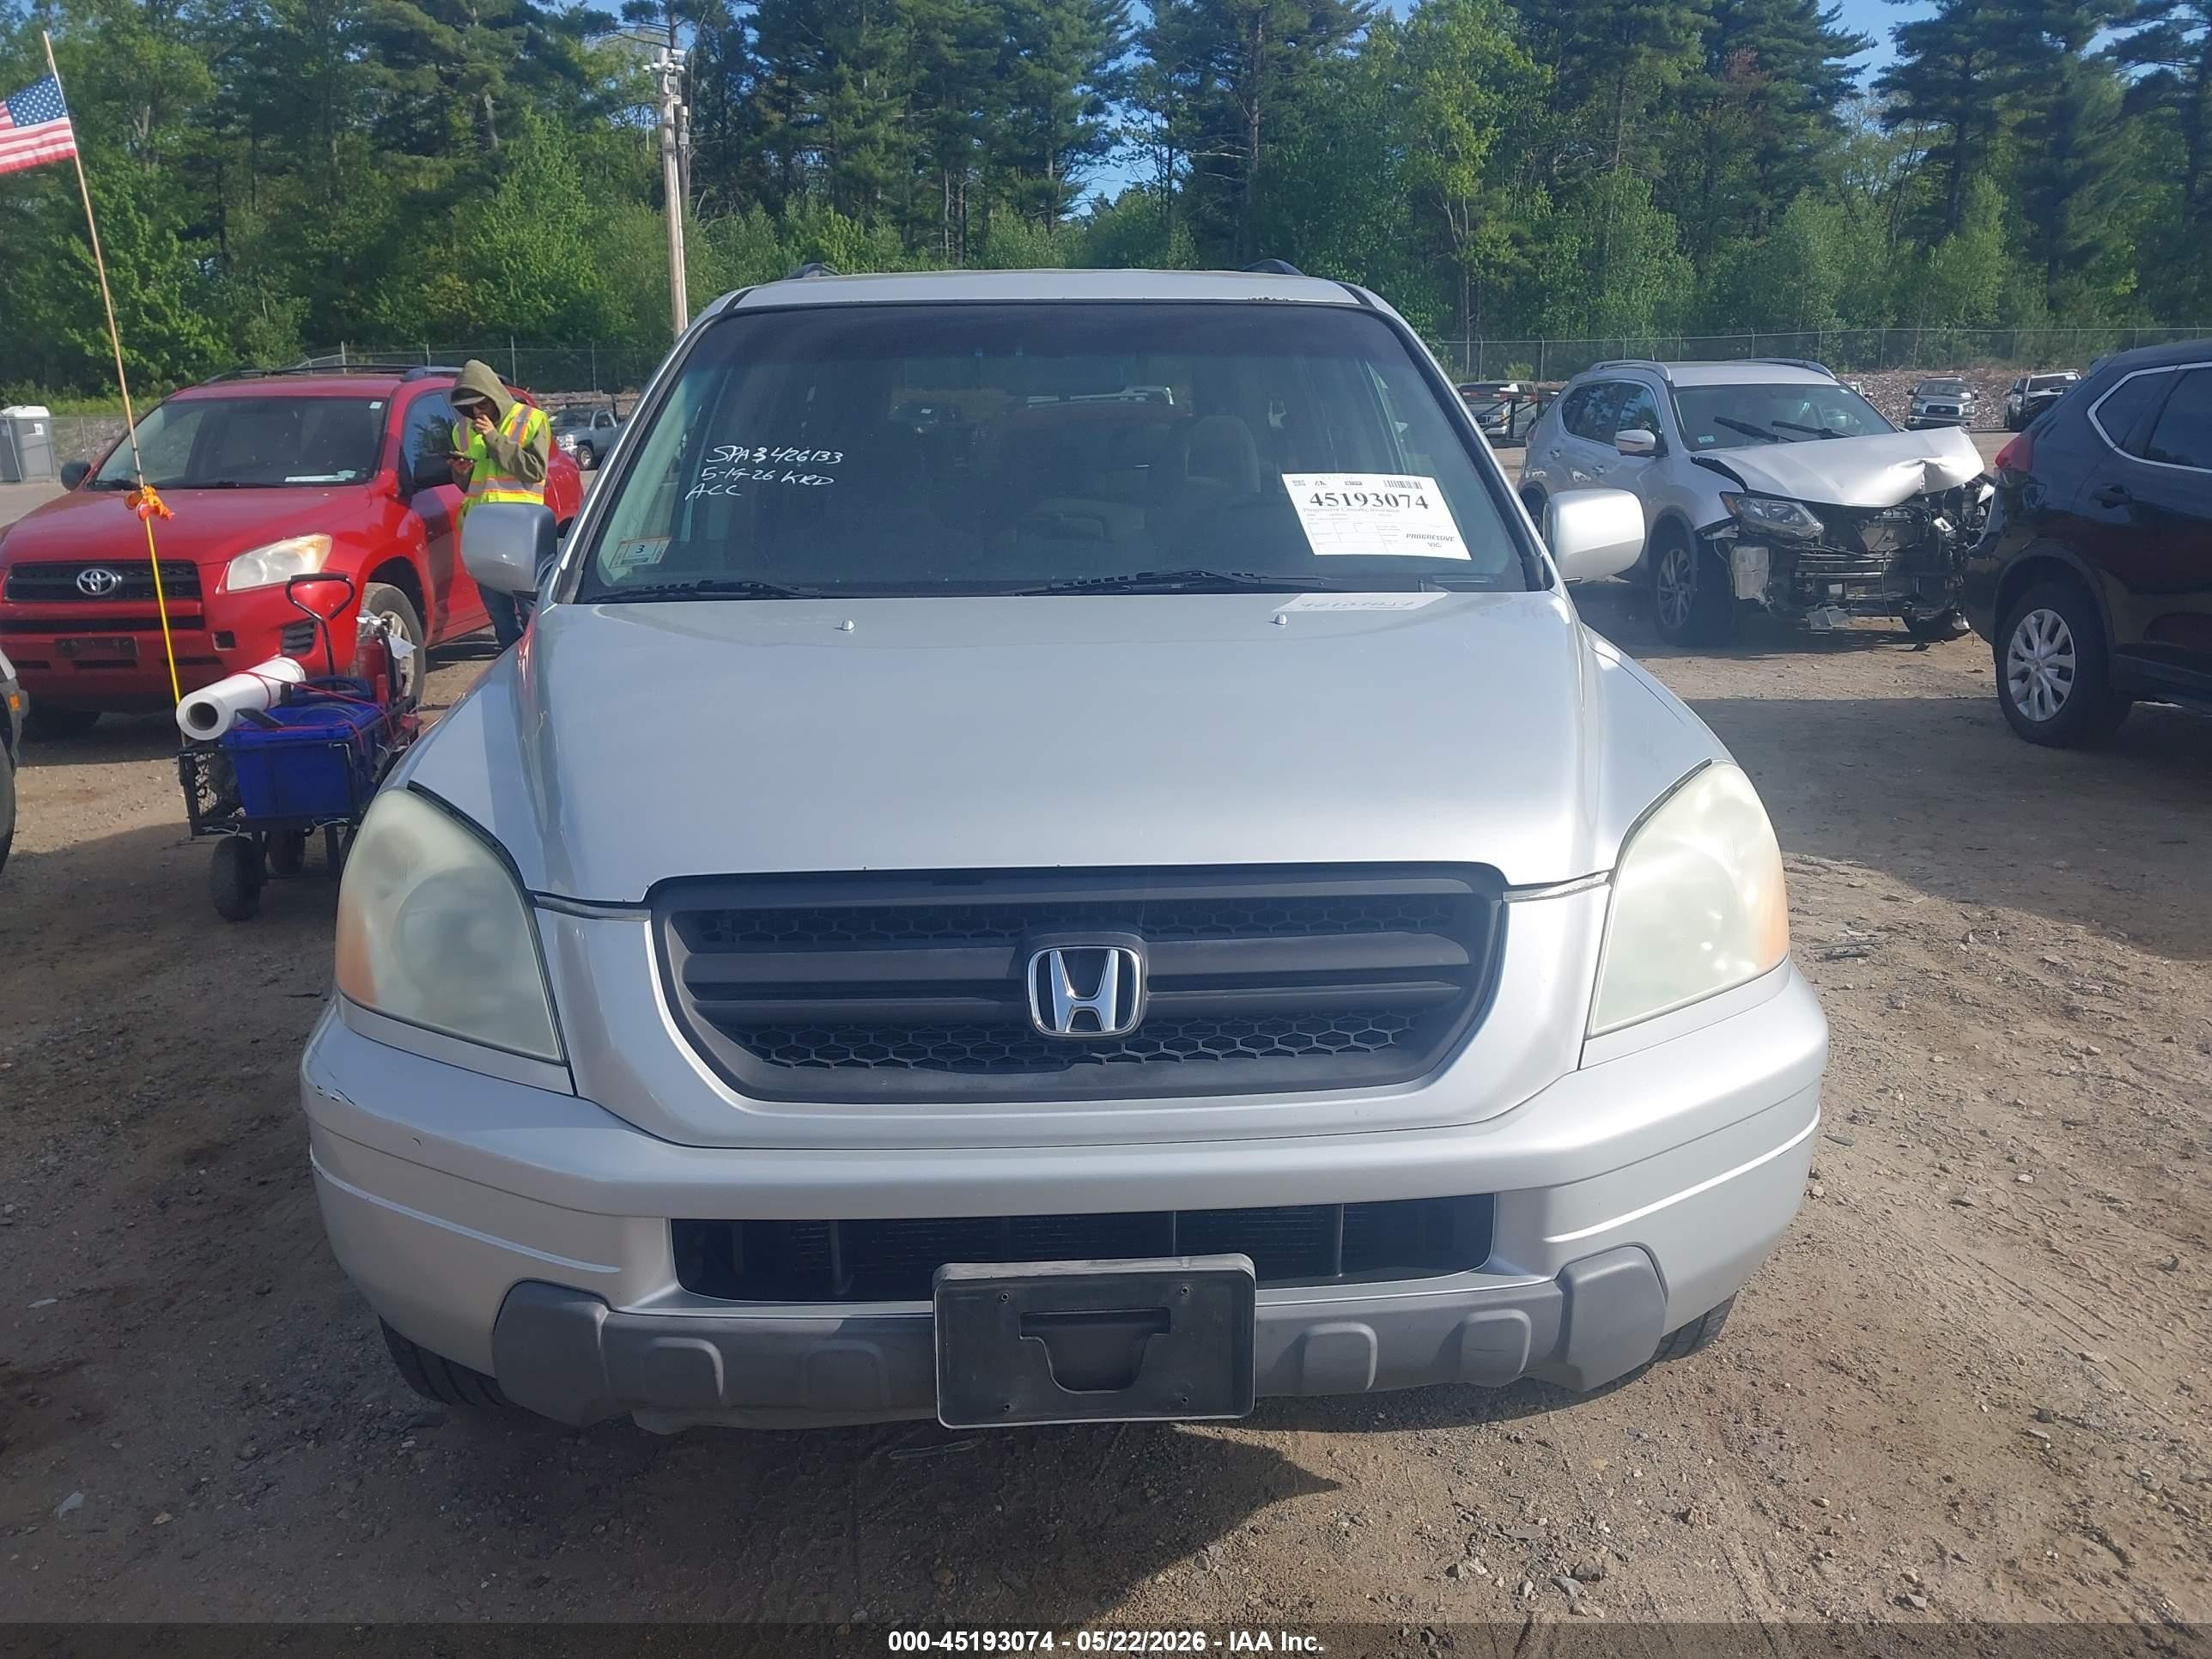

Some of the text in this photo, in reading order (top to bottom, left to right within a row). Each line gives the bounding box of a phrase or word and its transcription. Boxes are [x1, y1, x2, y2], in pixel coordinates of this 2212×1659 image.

[684, 483, 743, 501] ACC
[1309, 492, 1429, 509] 45193074
[635, 544, 646, 554] 3
